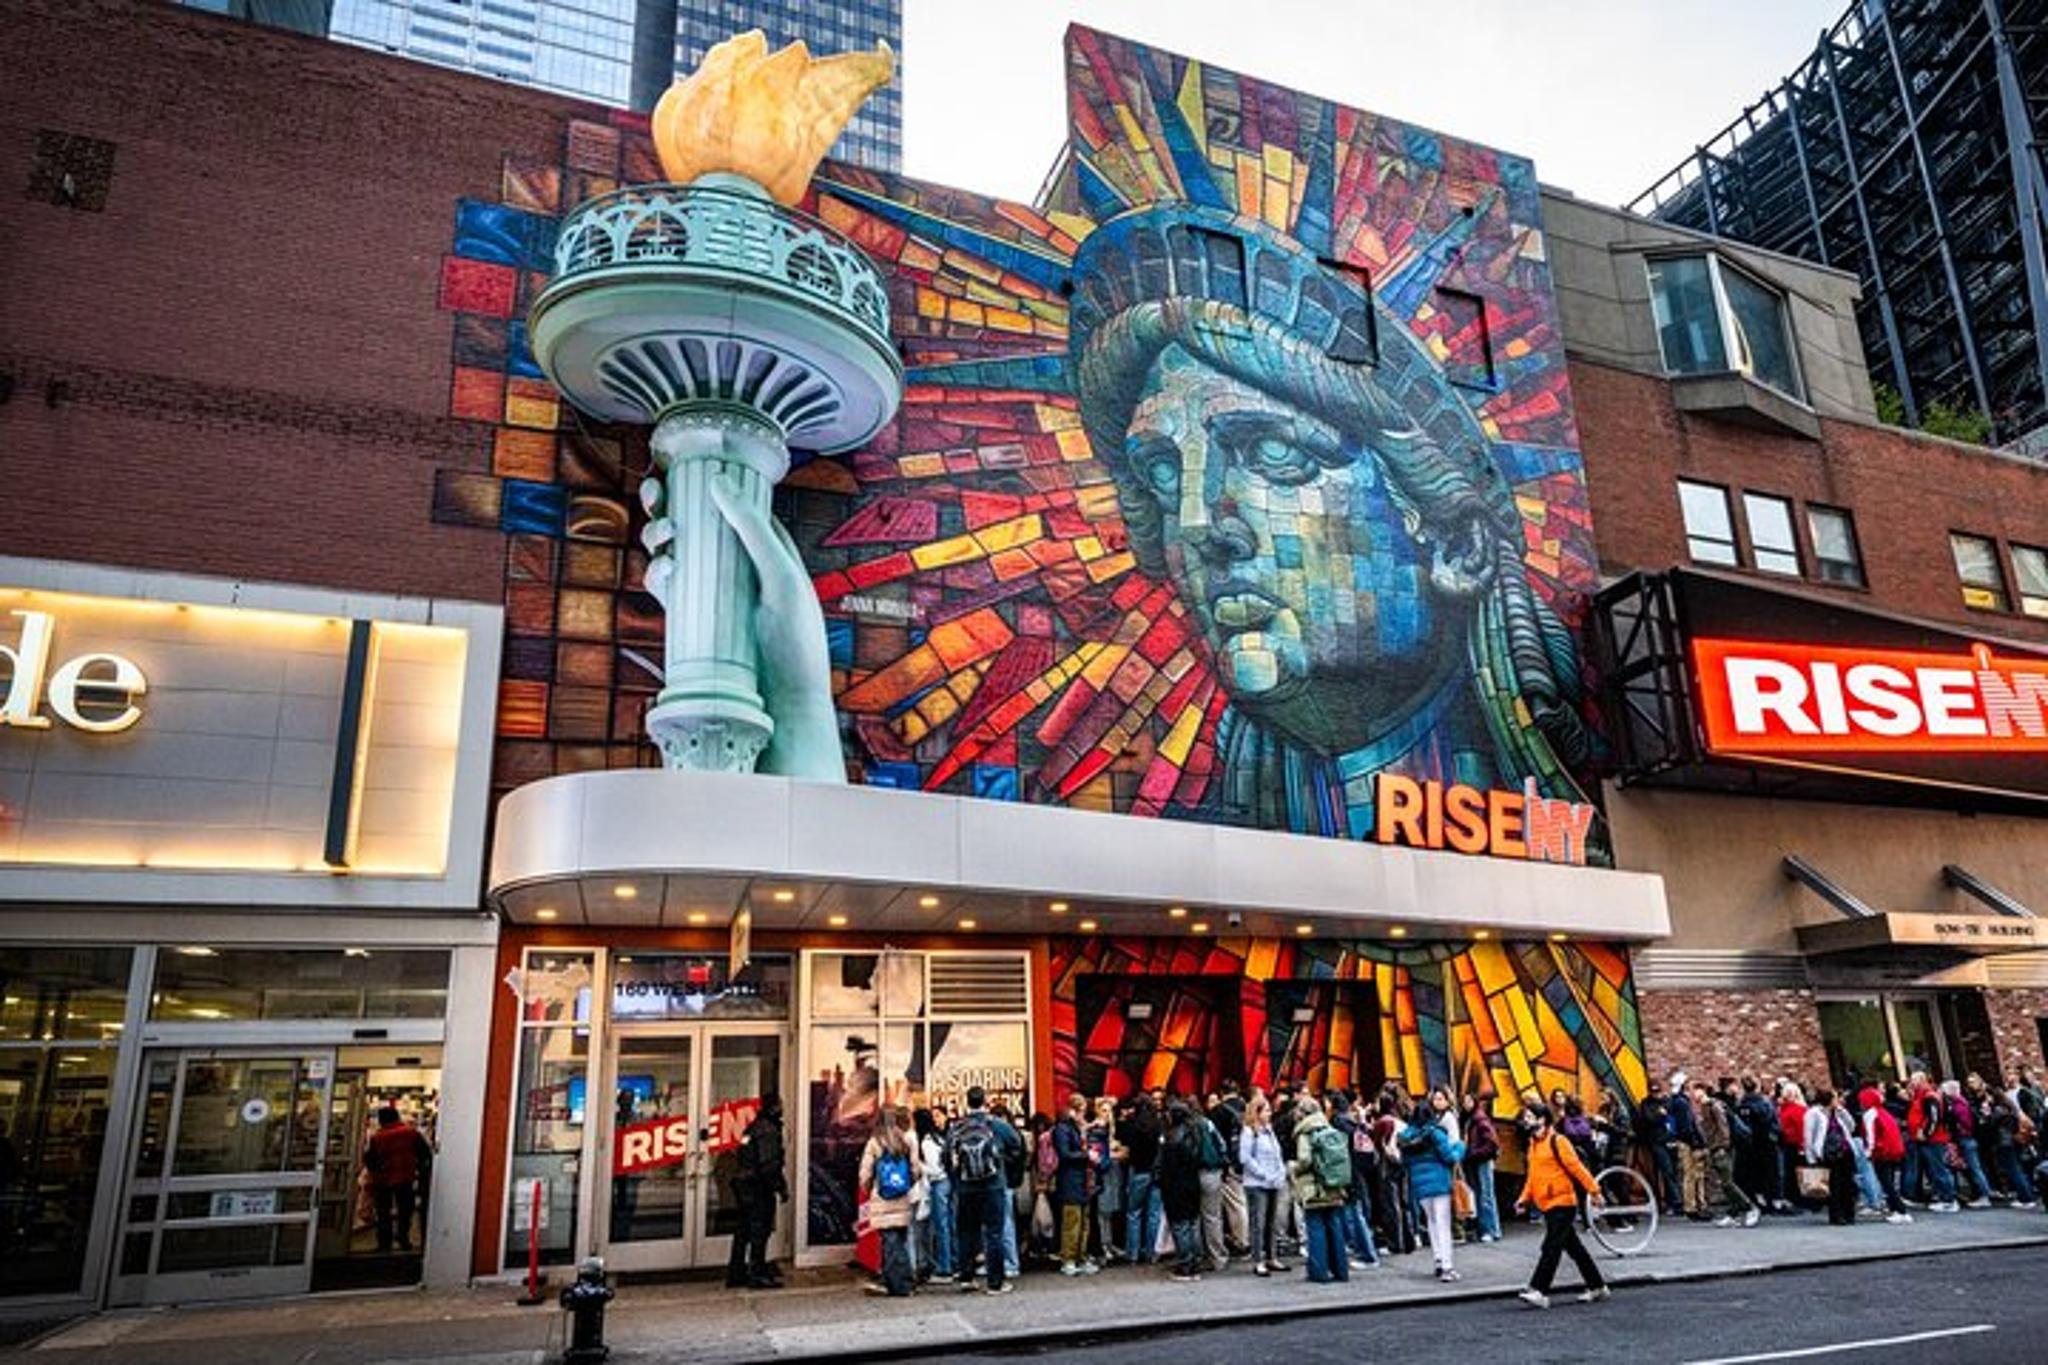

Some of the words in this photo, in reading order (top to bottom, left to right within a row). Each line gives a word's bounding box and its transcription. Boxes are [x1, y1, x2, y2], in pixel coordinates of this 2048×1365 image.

[1724, 644, 2048, 738] RISEN
[616, 981, 649, 996] 160
[653, 981, 706, 996] WEST
[947, 1068, 1024, 1092] SOARING
